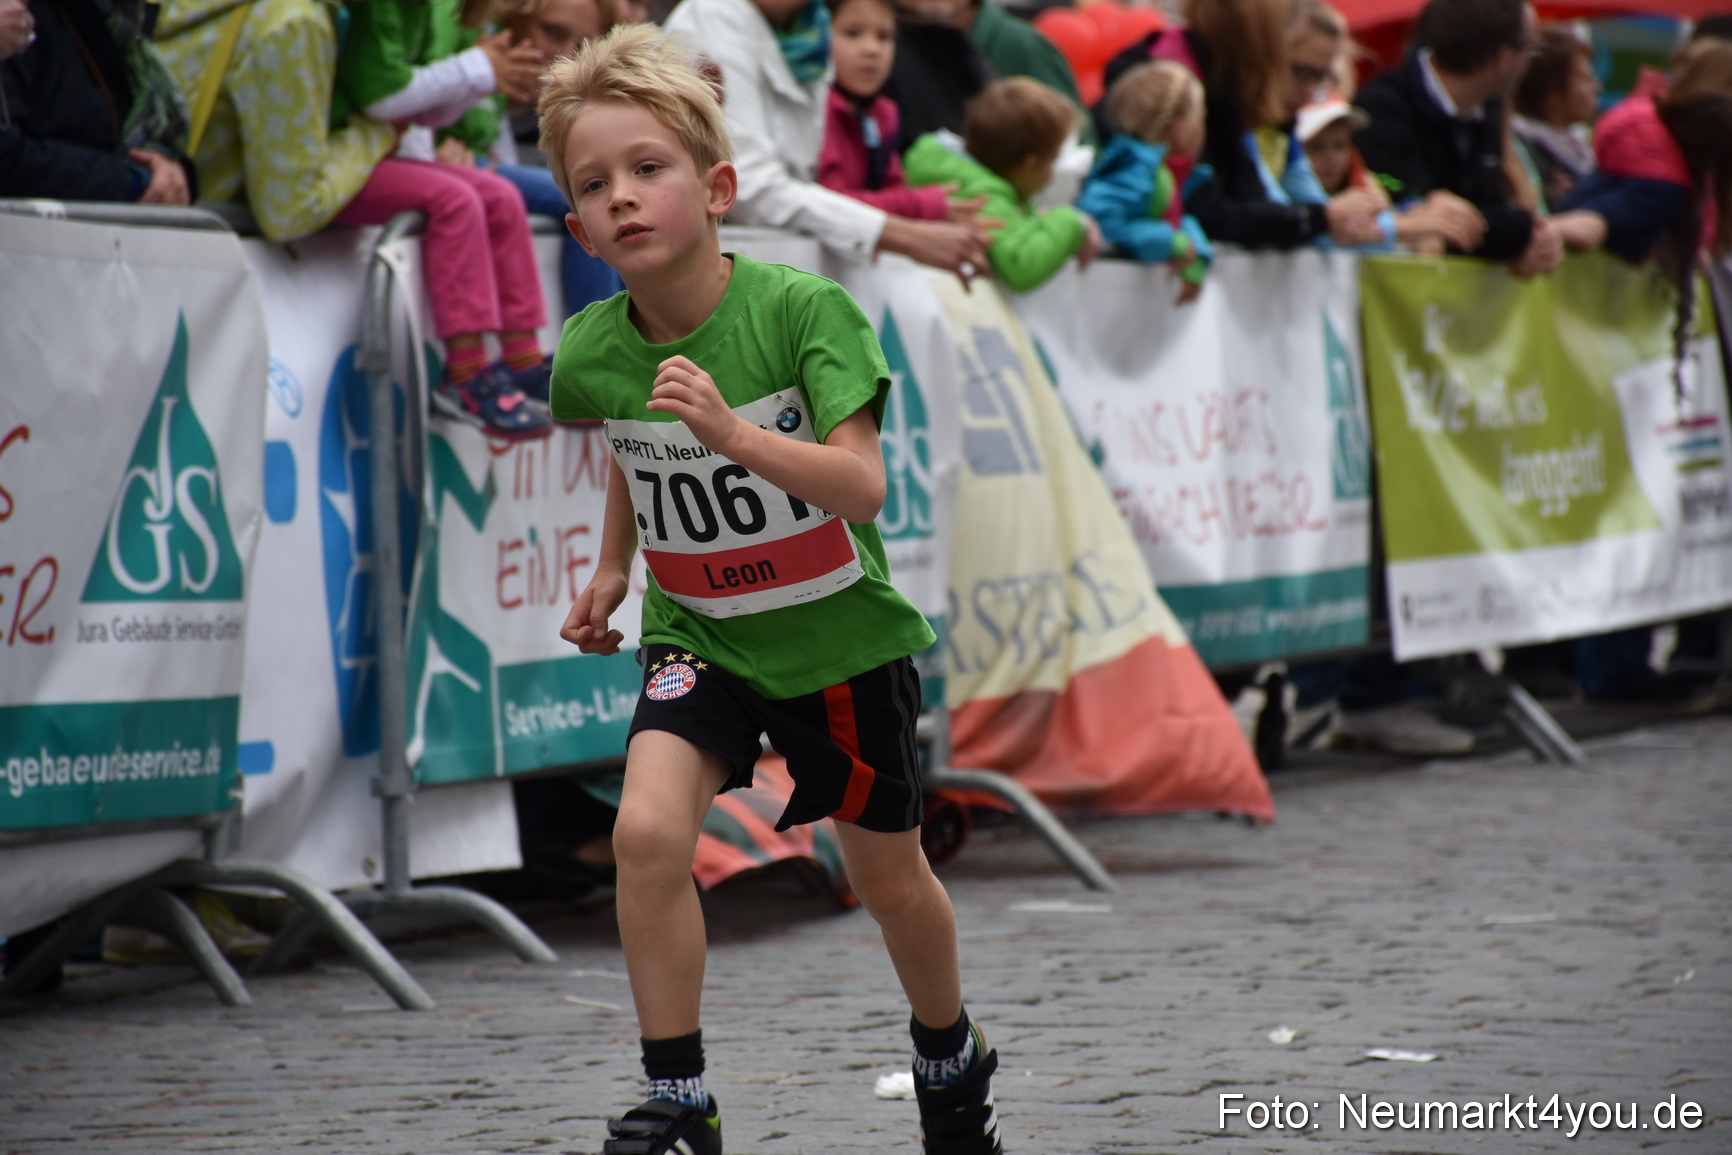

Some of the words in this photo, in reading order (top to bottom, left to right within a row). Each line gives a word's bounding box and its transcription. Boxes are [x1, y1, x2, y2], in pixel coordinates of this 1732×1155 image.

[611, 437, 664, 461] PARTL
[703, 559, 777, 590] Leon
[77, 617, 108, 644] Jura
